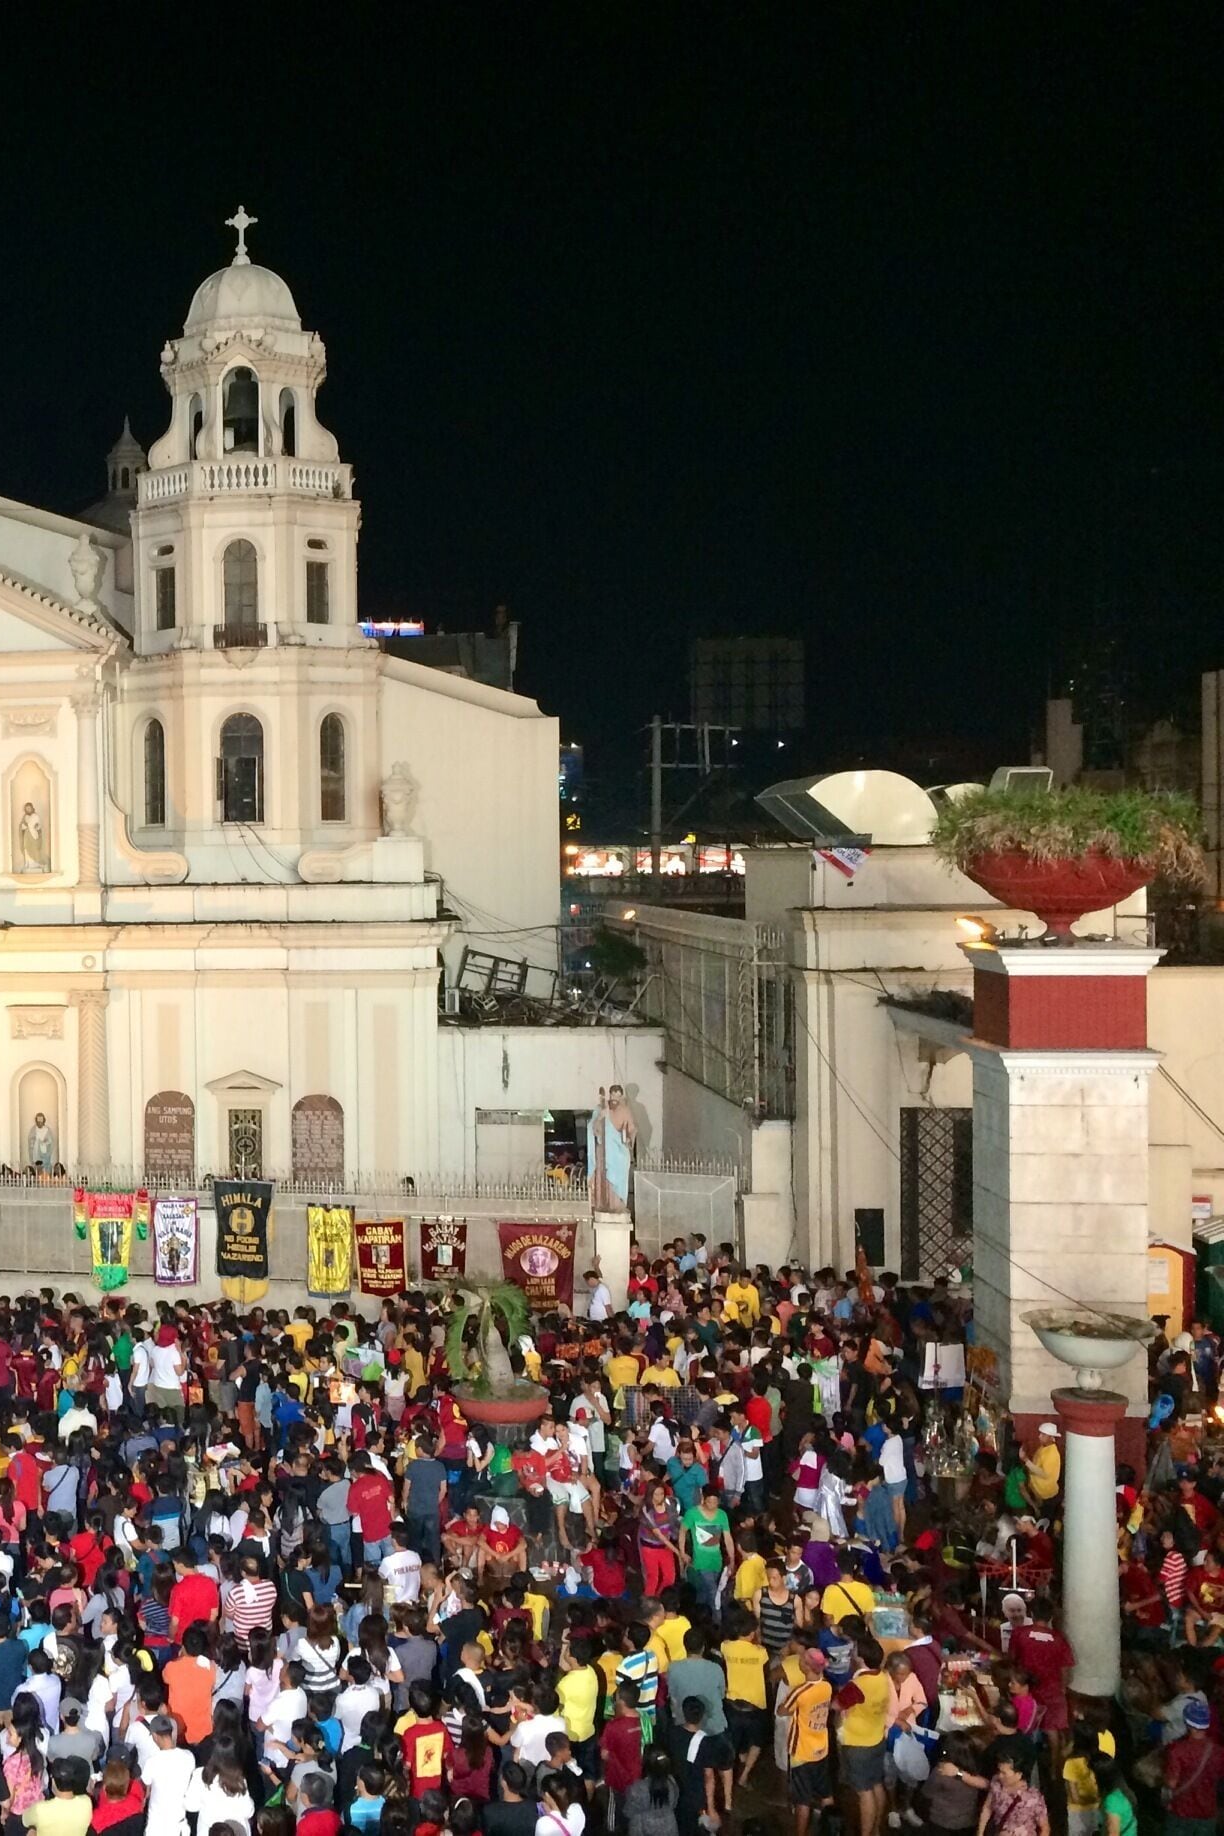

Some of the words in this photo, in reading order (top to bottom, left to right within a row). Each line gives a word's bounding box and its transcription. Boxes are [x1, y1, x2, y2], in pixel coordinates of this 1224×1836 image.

[159, 1115, 178, 1124] UTOS
[221, 1192, 262, 1208] HIMALA
[231, 1209, 253, 1232] H
[504, 1238, 524, 1260] HIJOS
[520, 1234, 532, 1247] DE
[531, 1234, 572, 1259] NAZARENO
[221, 1251, 264, 1262] NAZARENO
[525, 1285, 556, 1297] CHAPTER
